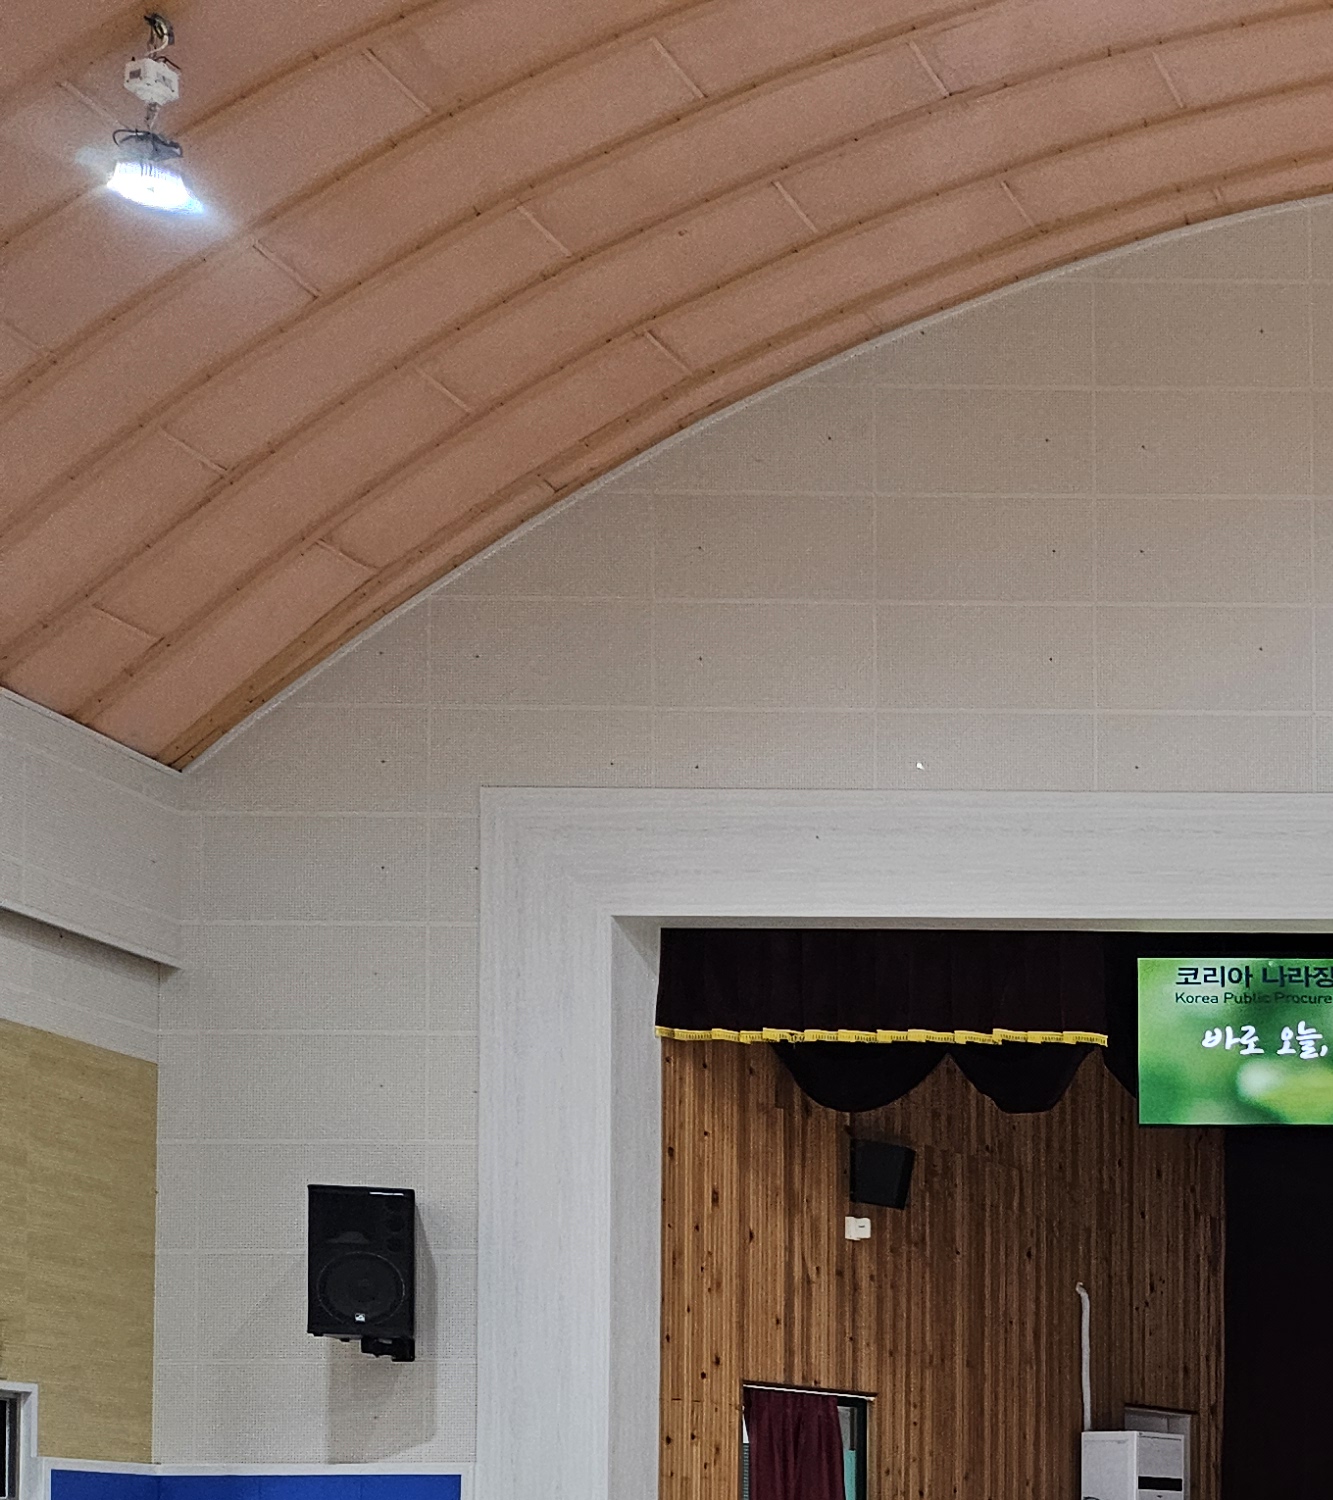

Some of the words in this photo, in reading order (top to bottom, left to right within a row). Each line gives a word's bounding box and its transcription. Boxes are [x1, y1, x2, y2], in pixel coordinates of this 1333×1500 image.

[1175, 966, 1253, 987] 코리아
[1175, 992, 1219, 1004] Korea
[1223, 992, 1272, 1004] Public
[1201, 1025, 1265, 1055] 바로
[1276, 1020, 1328, 1060] 오늘,
